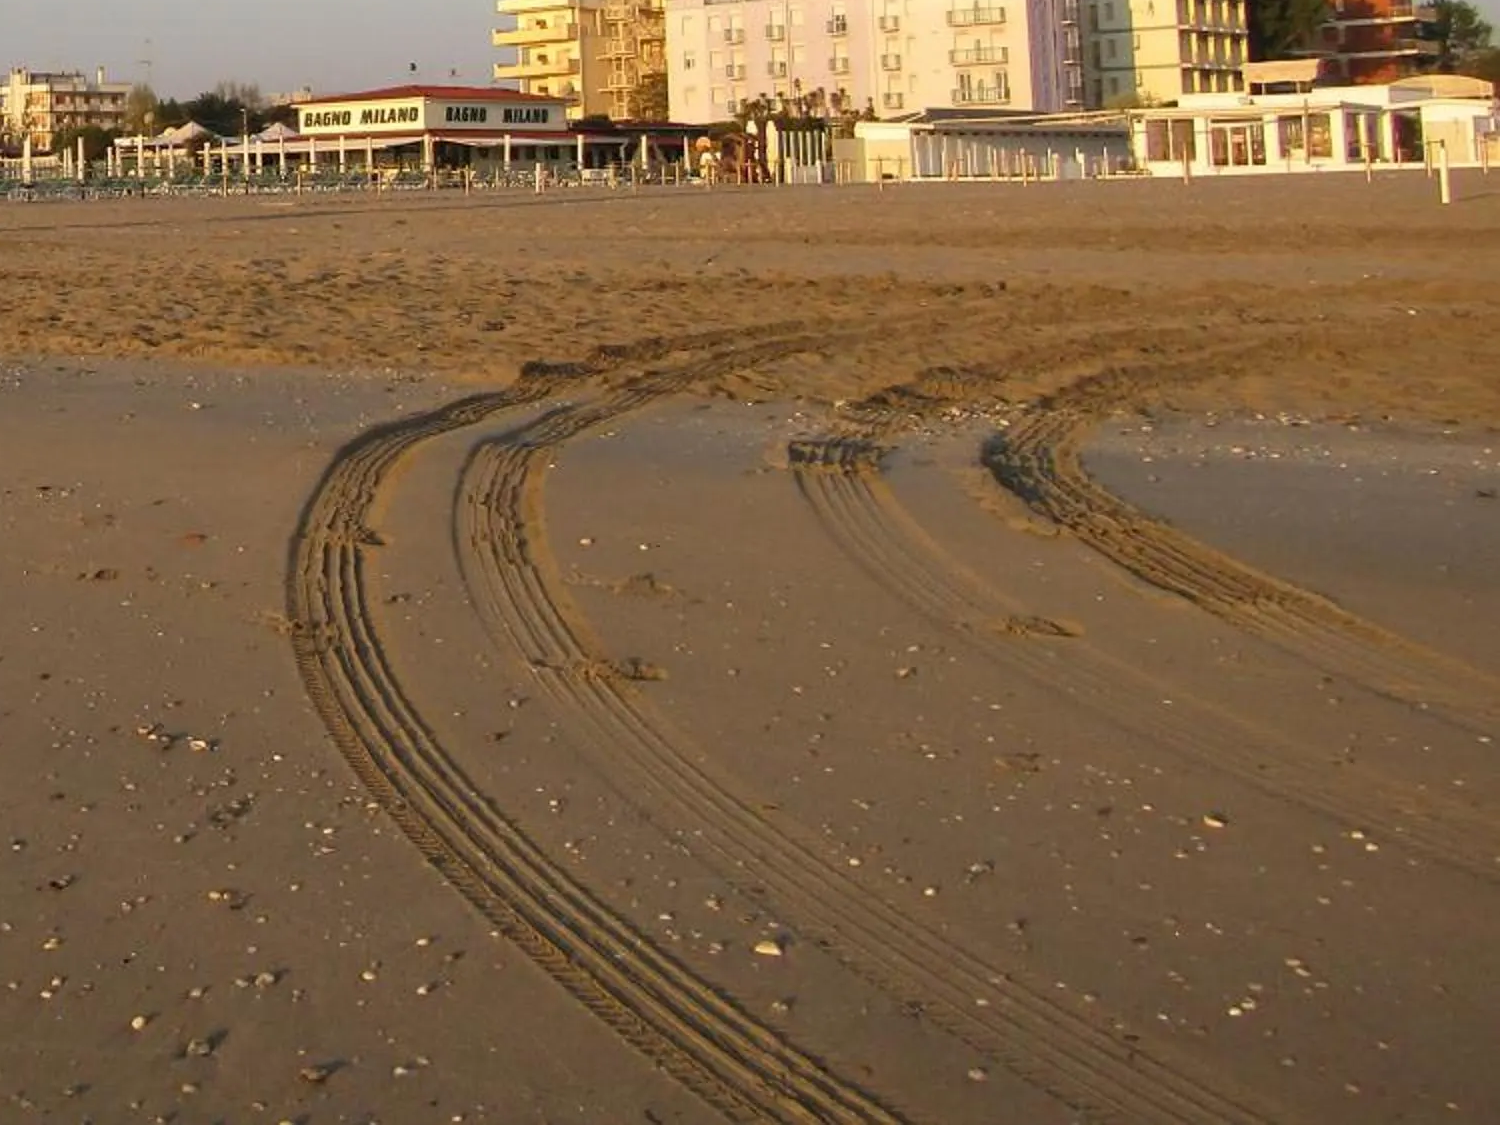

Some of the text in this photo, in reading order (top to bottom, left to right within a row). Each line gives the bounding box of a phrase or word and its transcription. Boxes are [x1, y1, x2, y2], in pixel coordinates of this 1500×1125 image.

[304, 107, 419, 127] BAGNO MILANO
[445, 106, 548, 124] BAGNO MILANO
